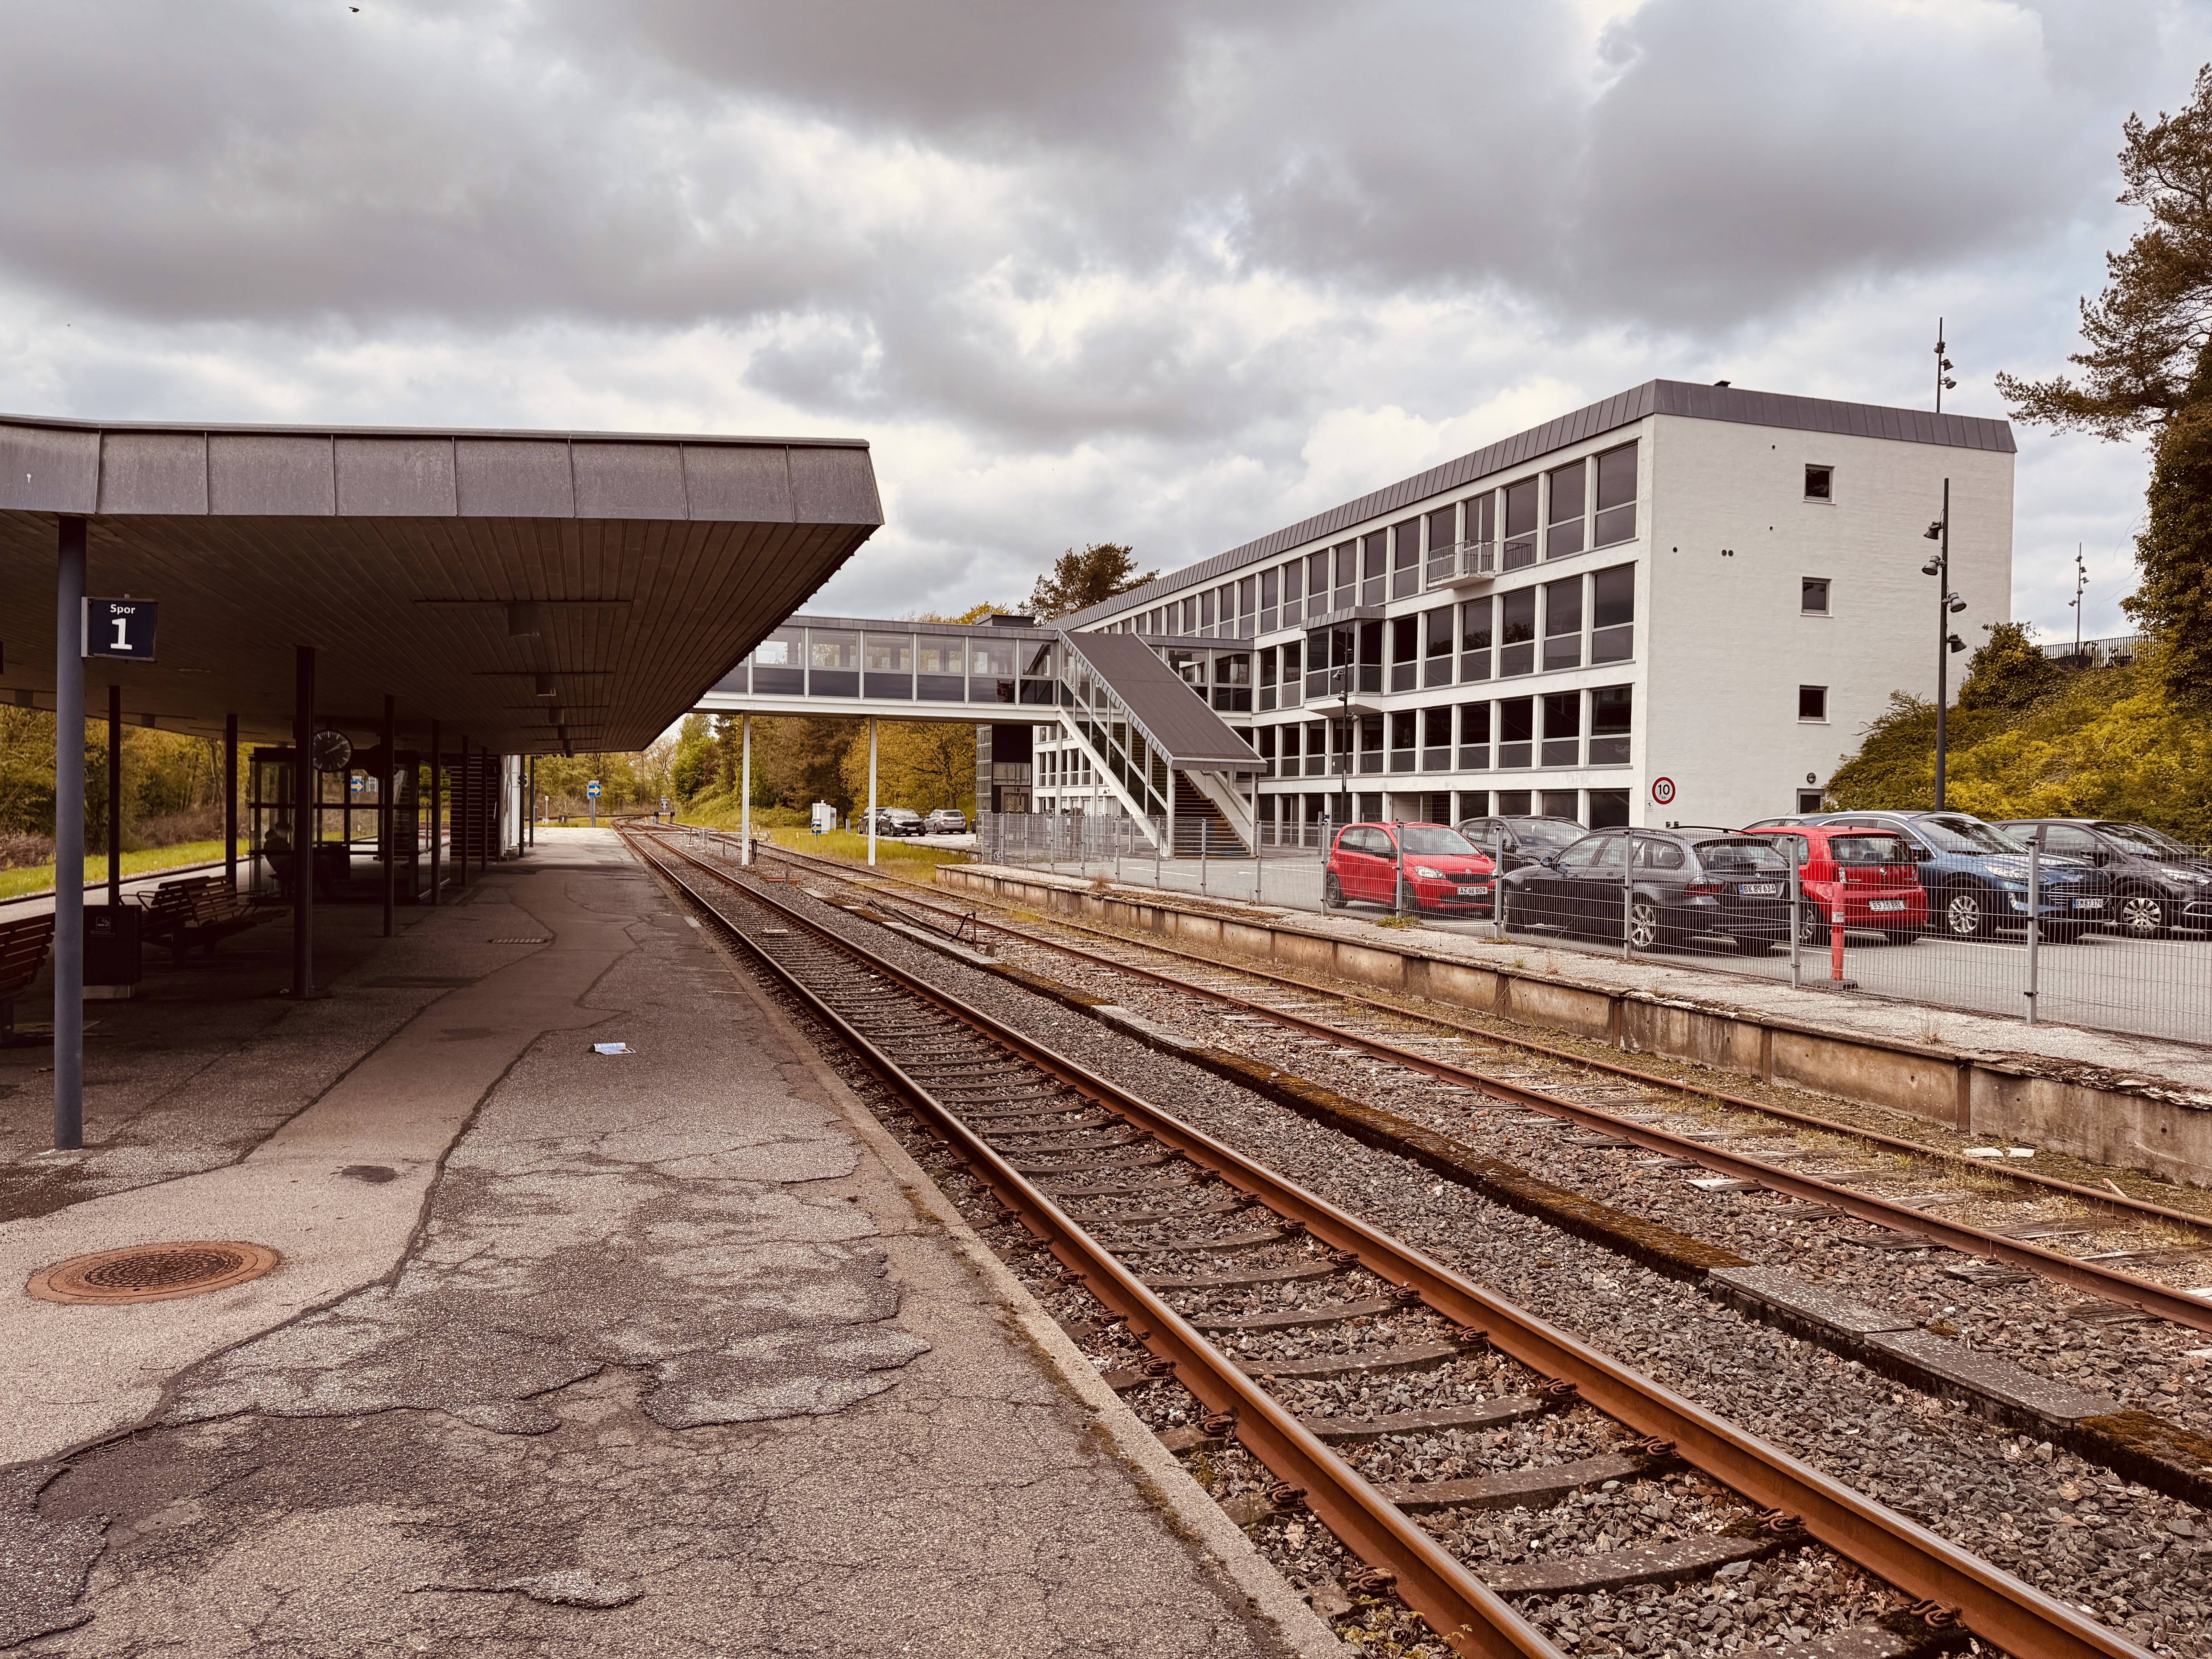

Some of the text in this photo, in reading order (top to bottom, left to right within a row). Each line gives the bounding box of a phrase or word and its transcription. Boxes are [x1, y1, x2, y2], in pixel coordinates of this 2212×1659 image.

[110, 604, 136, 615] Spor
[111, 618, 132, 650] 1
[1658, 784, 1670, 795] 10
